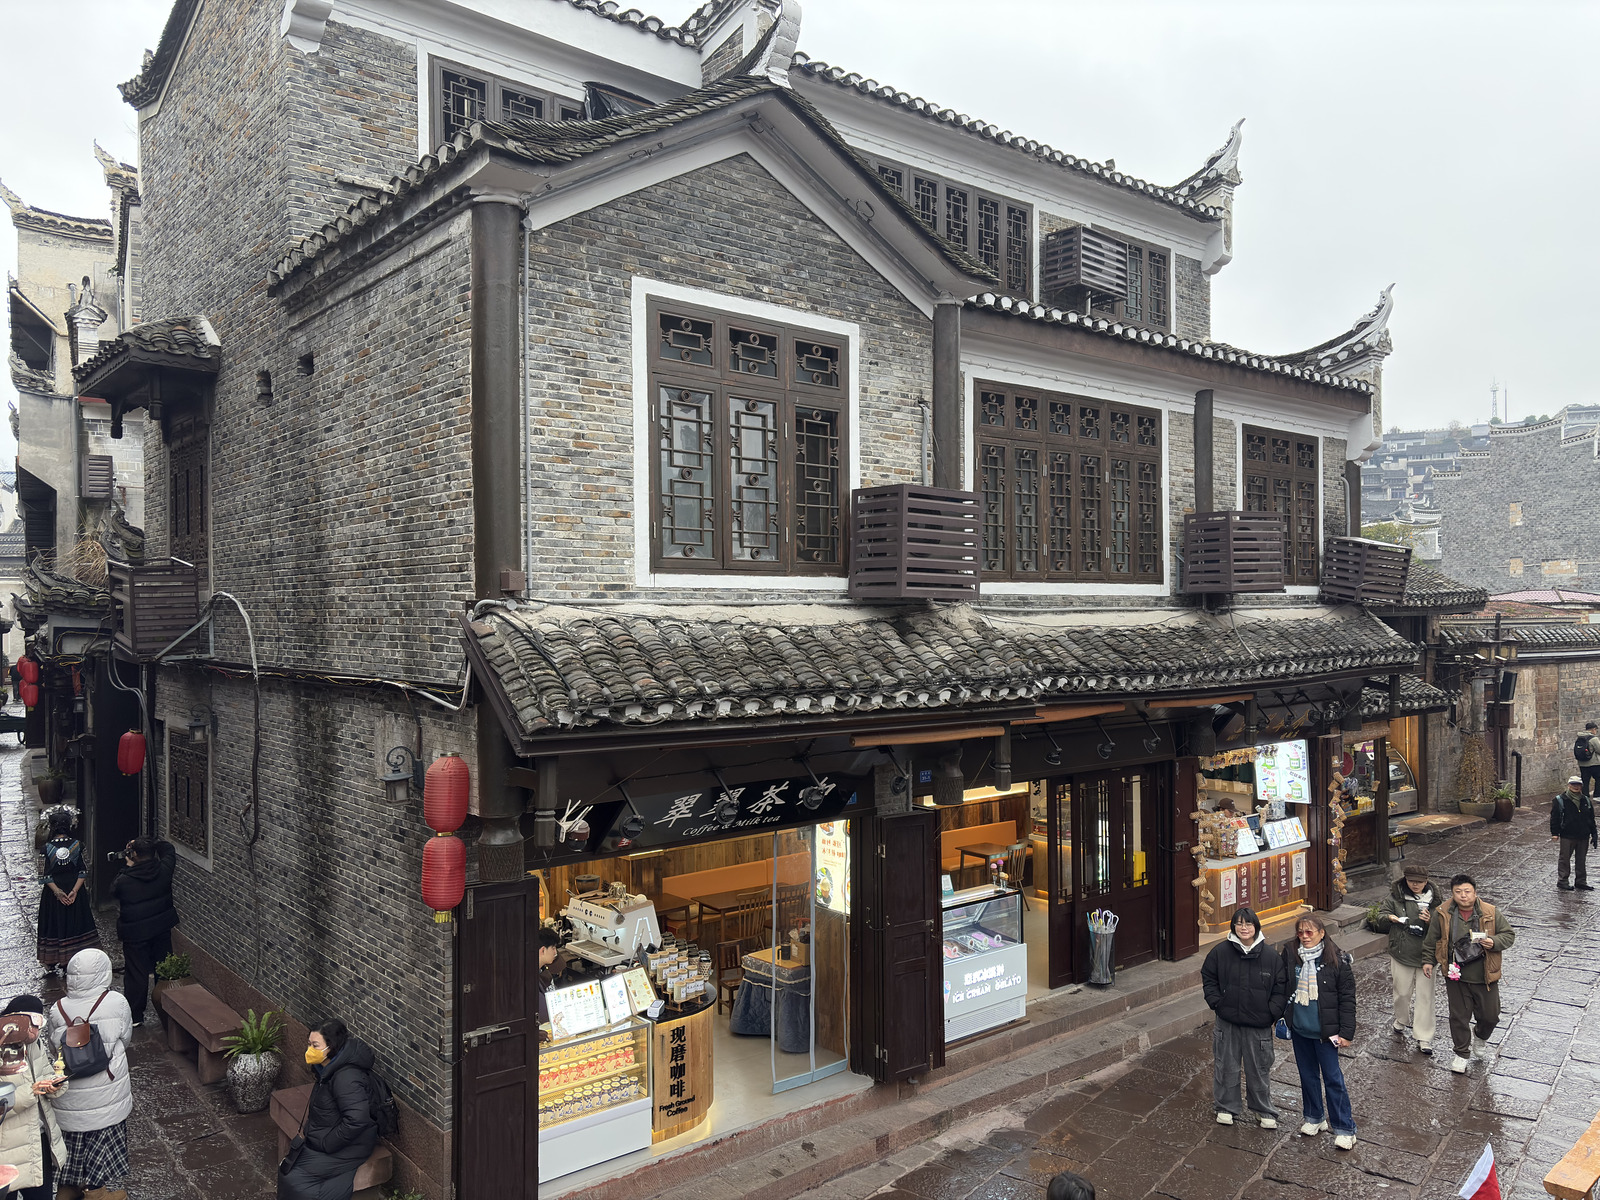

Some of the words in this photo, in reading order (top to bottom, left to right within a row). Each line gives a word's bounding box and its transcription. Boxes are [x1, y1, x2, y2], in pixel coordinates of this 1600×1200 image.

[682, 823, 720, 837] Coffee
[732, 817, 762, 829] Milk
[762, 815, 781, 824] tea
[670, 1025, 687, 1098] 现磨咖啡
[659, 1101, 675, 1112] Fresh
[675, 1095, 696, 1107] Ground
[666, 1106, 688, 1118] Coffee
